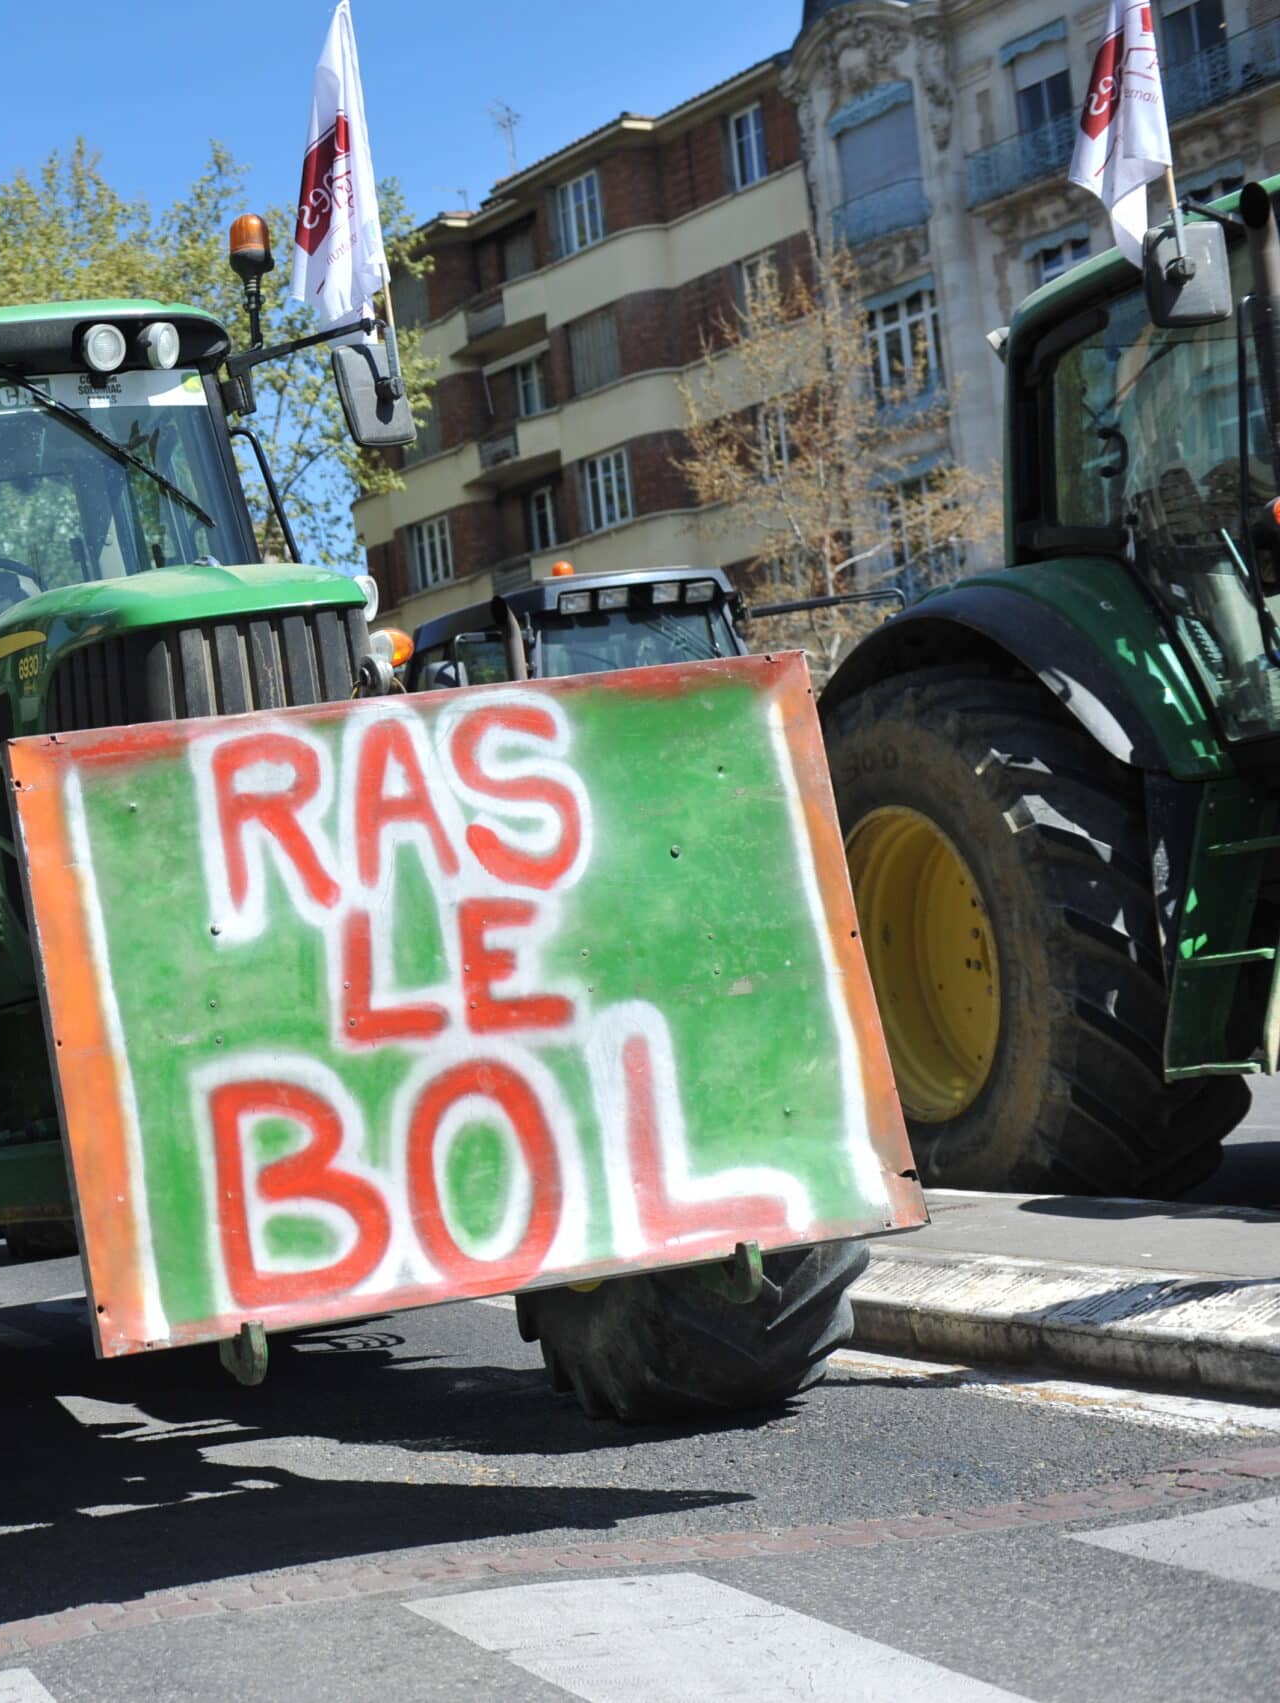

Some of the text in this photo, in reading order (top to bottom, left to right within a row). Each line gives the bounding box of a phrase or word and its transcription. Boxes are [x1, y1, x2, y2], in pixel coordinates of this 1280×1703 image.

[18, 655, 39, 680] 6930
[209, 702, 582, 912] RAS
[342, 897, 577, 1044] LE
[206, 1033, 790, 1310] BOL
